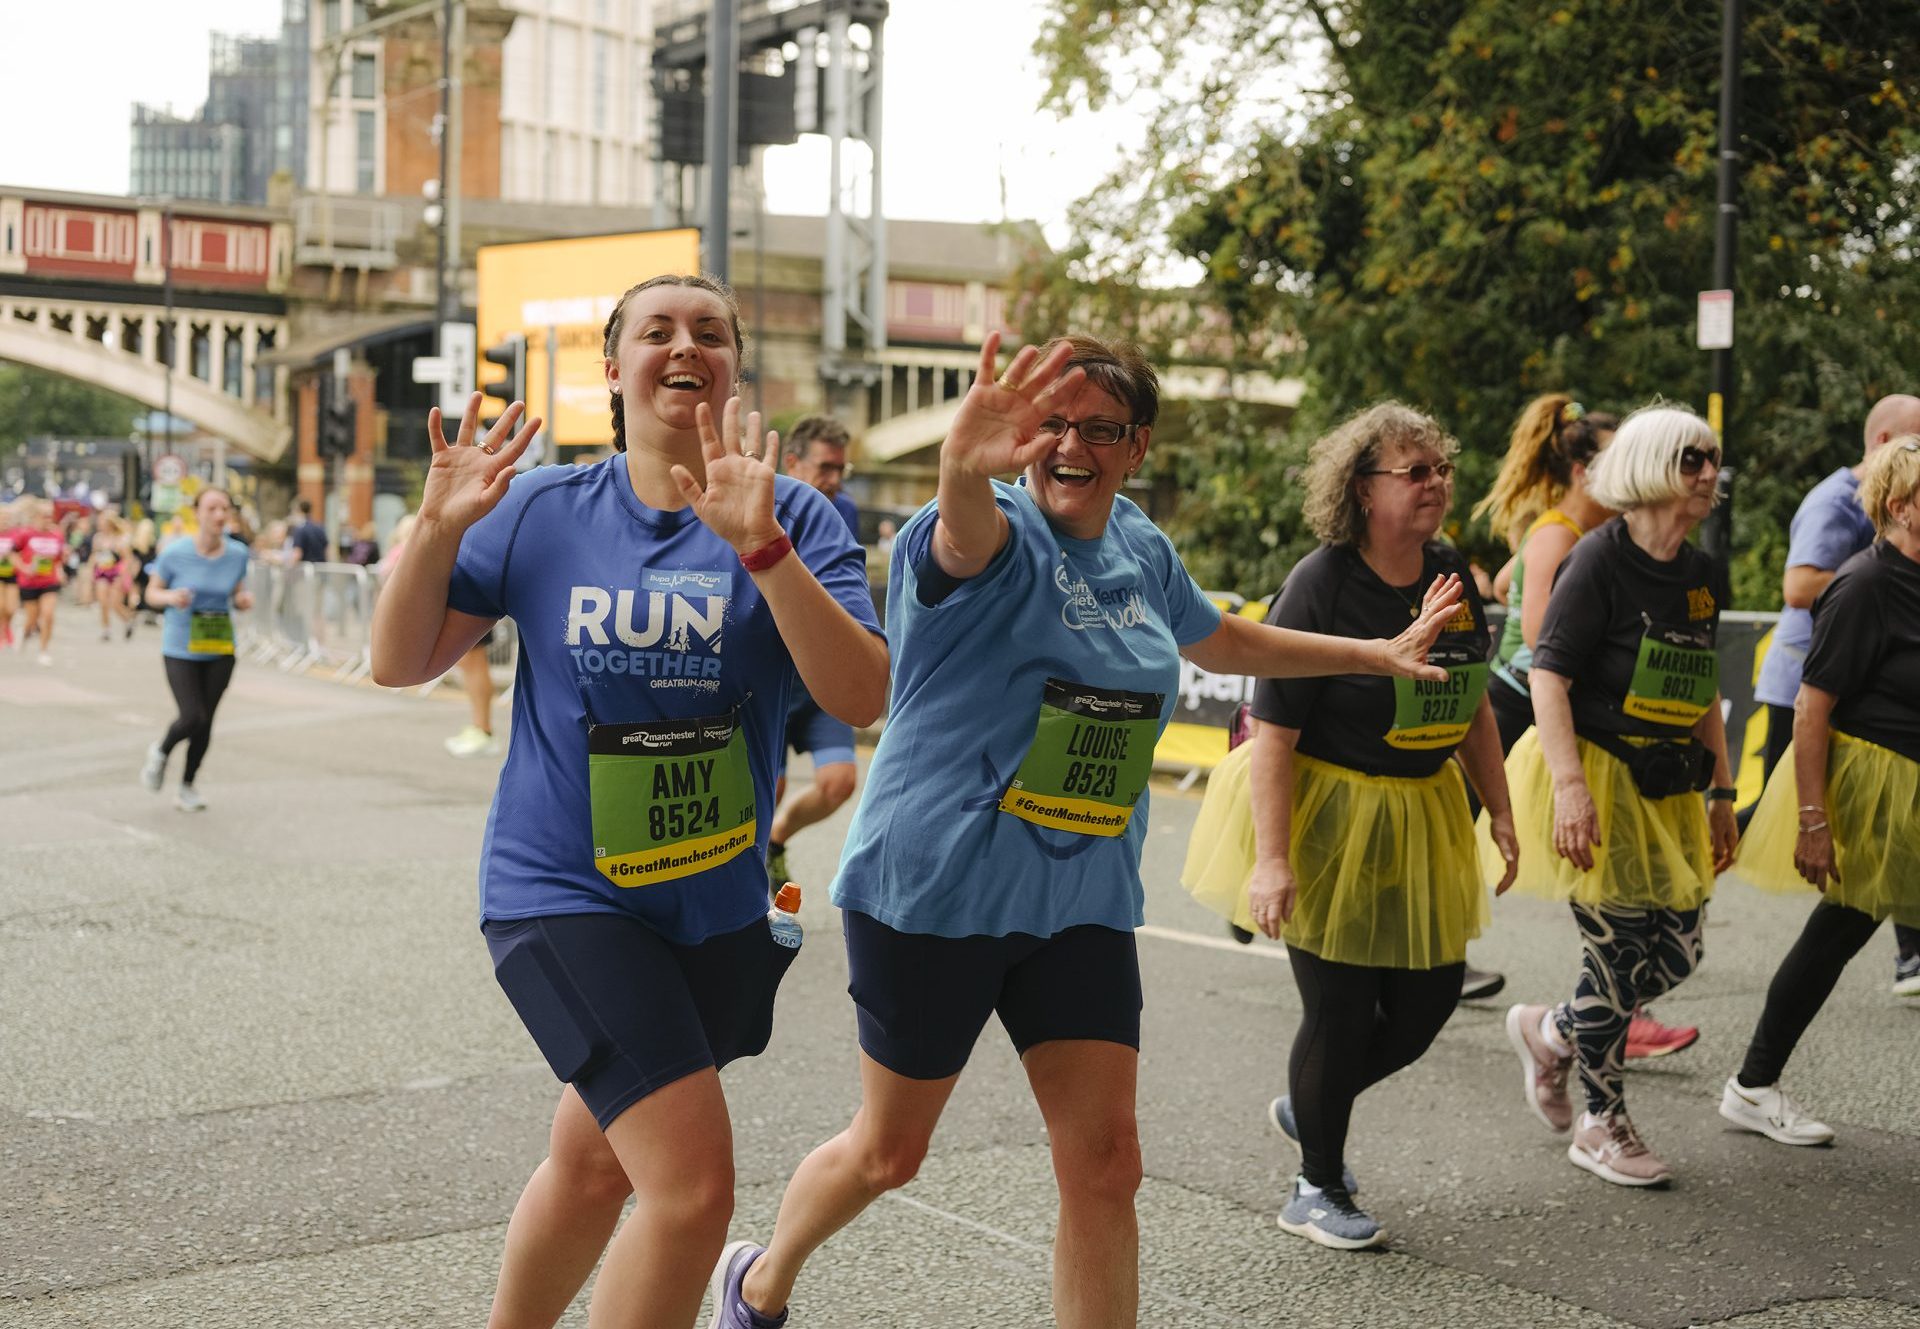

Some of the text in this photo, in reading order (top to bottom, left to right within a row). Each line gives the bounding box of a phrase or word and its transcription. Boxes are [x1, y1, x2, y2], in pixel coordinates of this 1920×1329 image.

[566, 586, 724, 654] RUN
[569, 648, 722, 678] TOGETHER
[1646, 647, 1713, 679] MARGARET
[650, 678, 721, 692] GREATRUN.ORG
[1415, 672, 1469, 697] AUDREY
[1661, 675, 1696, 699] 9031
[1421, 699, 1459, 722] 9216
[622, 734, 643, 745] great
[649, 731, 696, 742] manchester
[1066, 724, 1131, 760] LOUISE
[652, 759, 715, 800] AMY
[1062, 762, 1117, 797] 8523
[649, 796, 720, 841] 8524
[739, 804, 755, 824] 10K
[610, 833, 748, 877] #GreatManchesterRun
